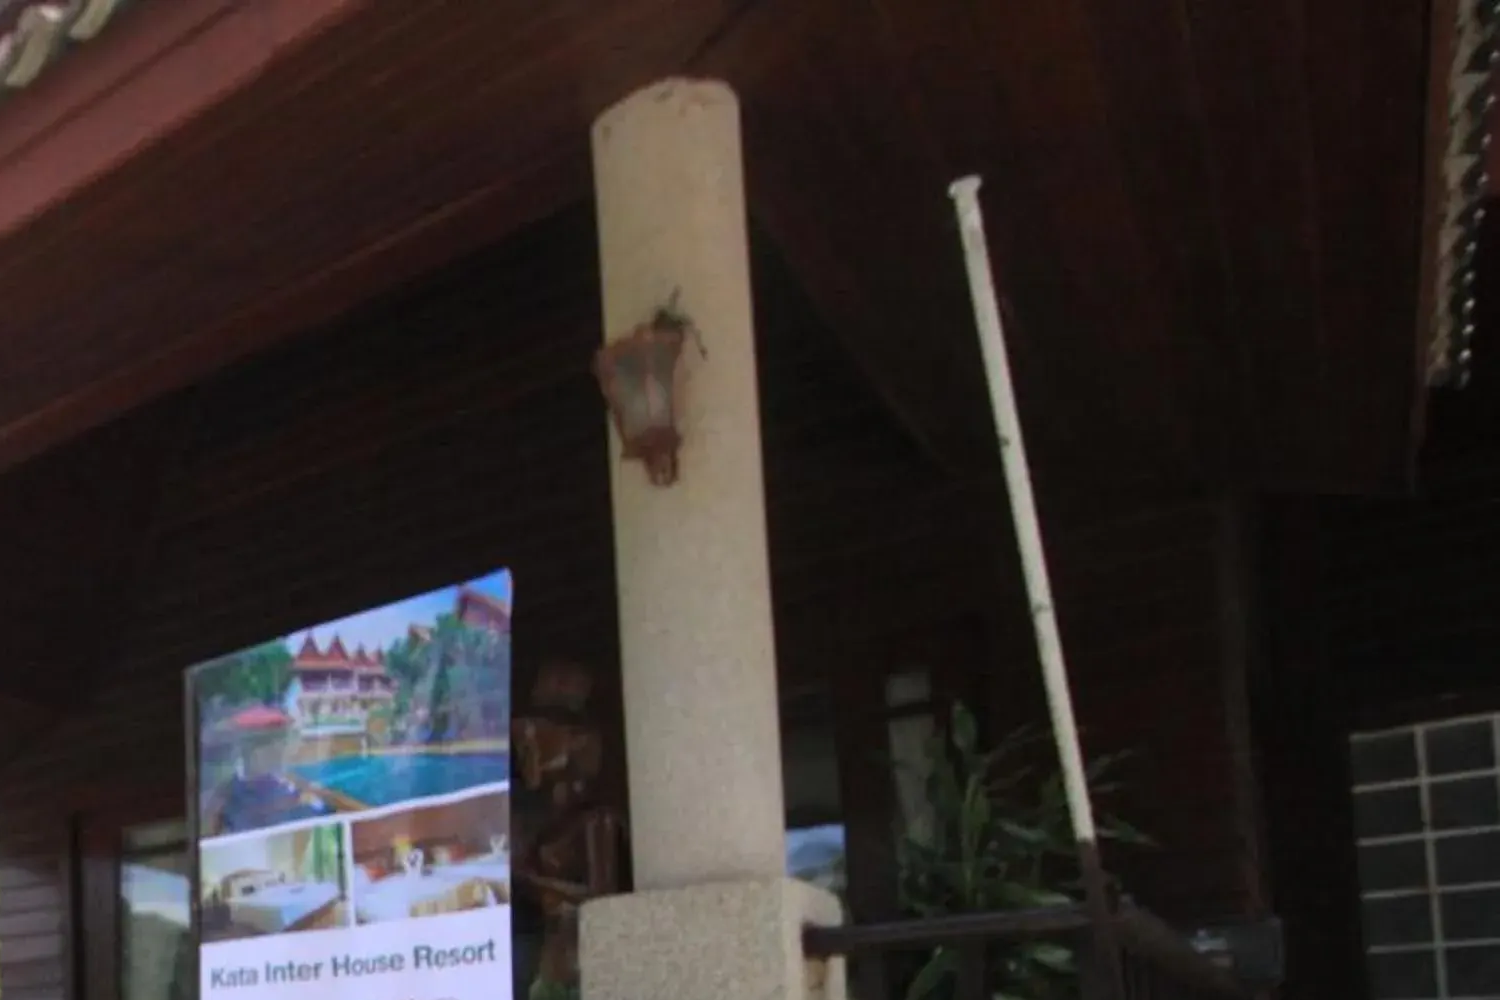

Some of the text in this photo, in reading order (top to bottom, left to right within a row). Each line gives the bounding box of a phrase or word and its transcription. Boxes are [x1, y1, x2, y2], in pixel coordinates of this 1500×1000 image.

[211, 938, 496, 989] Kata Inter House Resort
